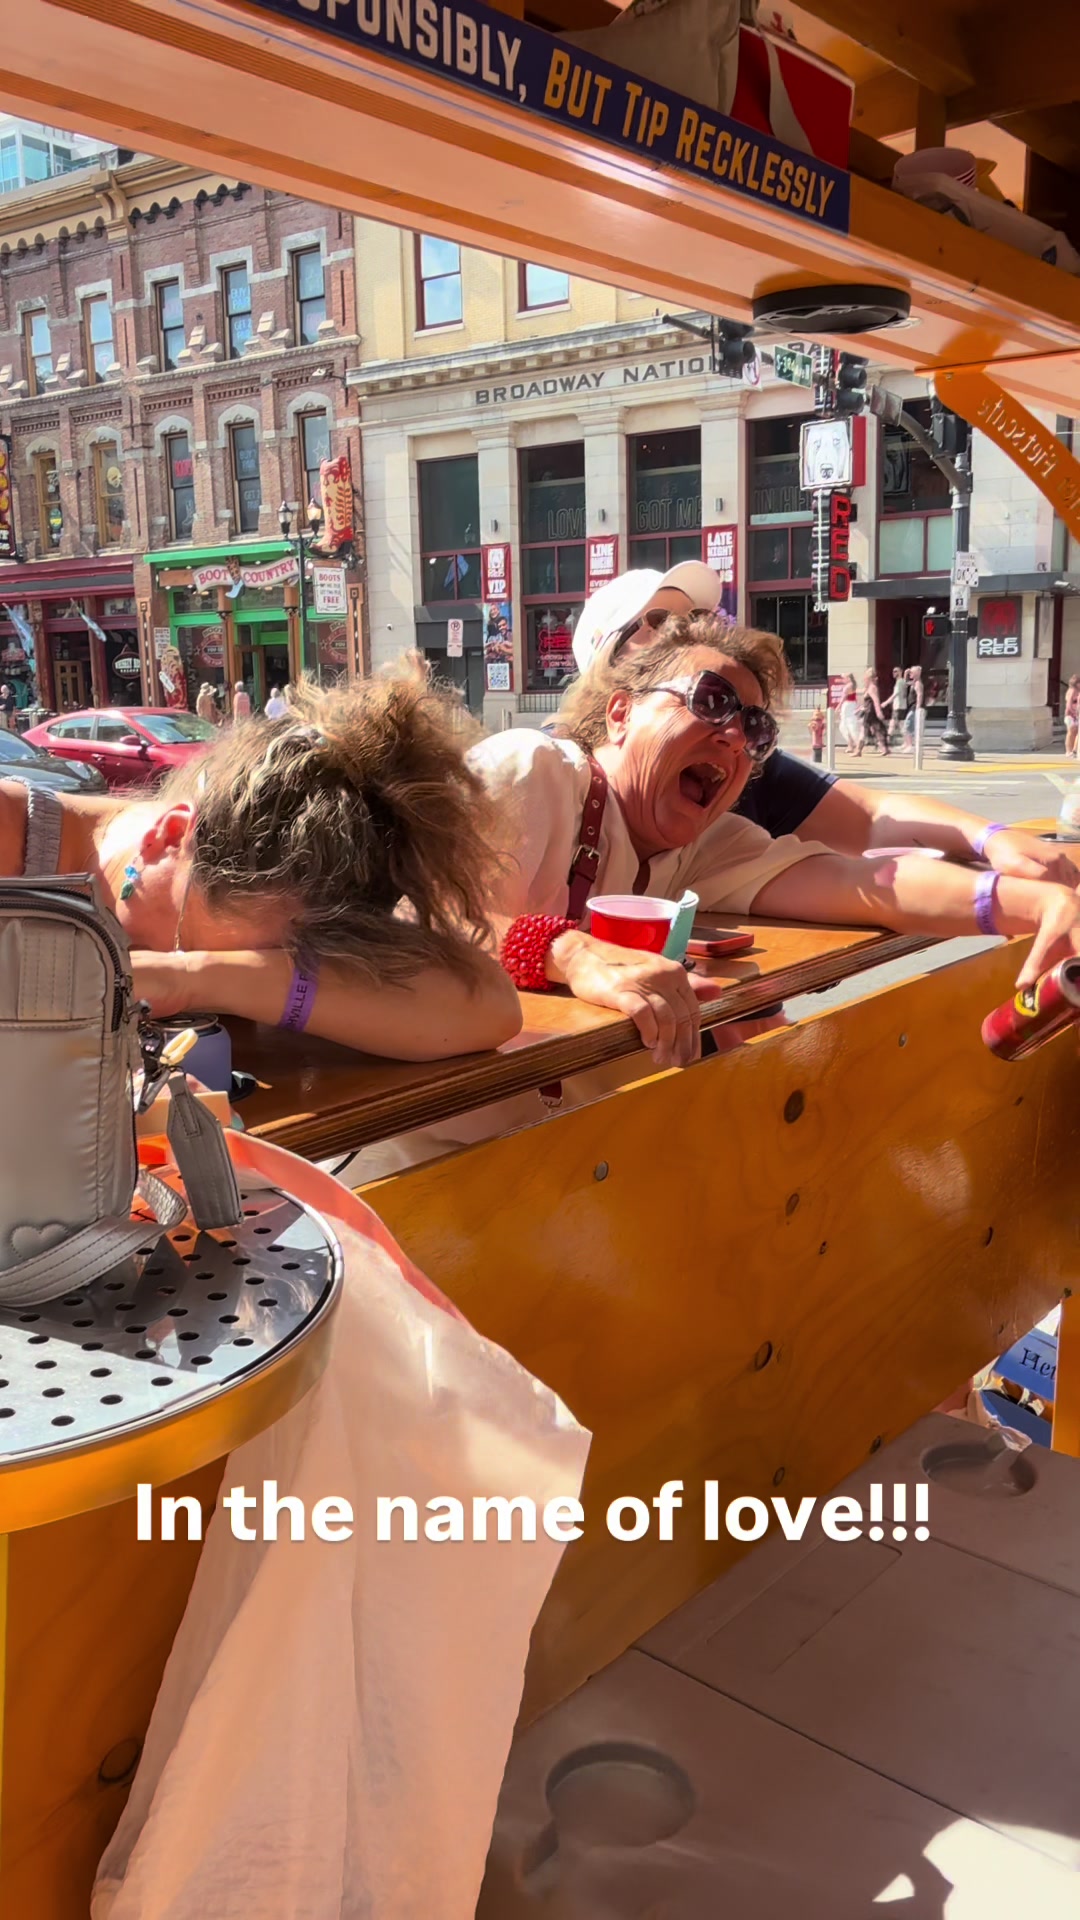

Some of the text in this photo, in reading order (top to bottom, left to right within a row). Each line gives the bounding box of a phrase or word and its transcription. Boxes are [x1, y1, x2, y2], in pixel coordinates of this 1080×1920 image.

[298, 0, 835, 217] ONSIBLY, BUT TIP RECKLESSLY
[475, 372, 605, 405] BROADWAY
[635, 499, 671, 531] GOT
[707, 531, 733, 546] LATE
[830, 492, 851, 599] RED
[590, 543, 614, 557] LINE
[198, 558, 294, 585] BOOT COUNTRY
[318, 573, 341, 581] BOOTS
[488, 579, 506, 594] VIP
[323, 596, 340, 604] FREE
[979, 637, 1018, 646] OLE
[979, 646, 1018, 655] RED
